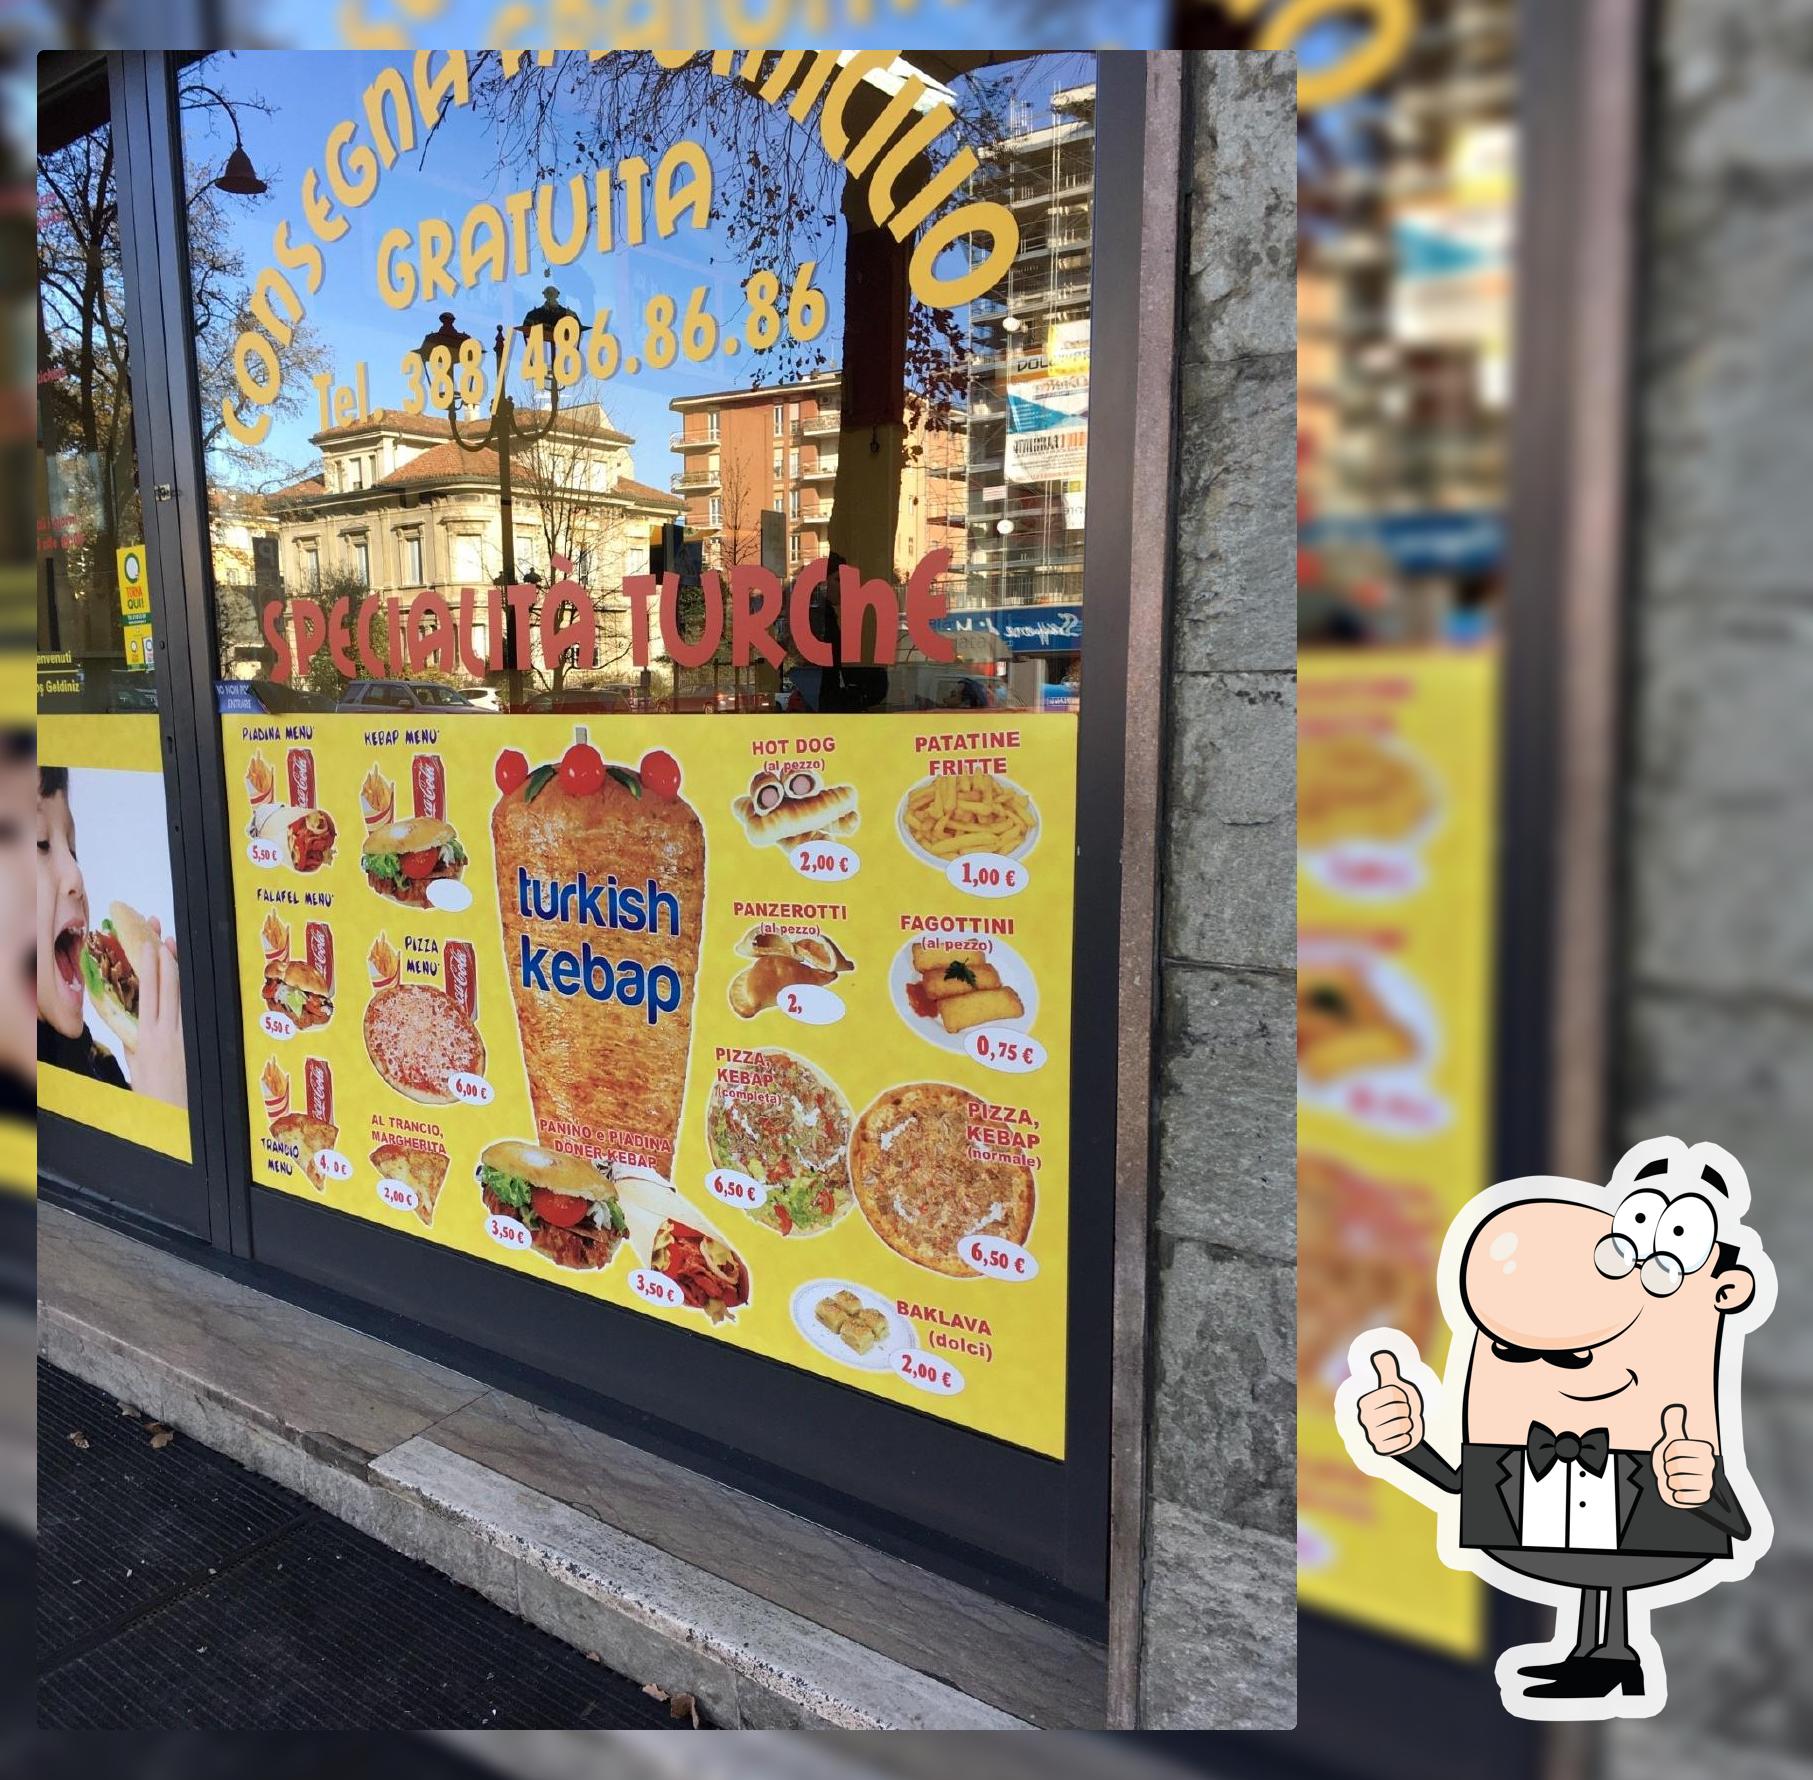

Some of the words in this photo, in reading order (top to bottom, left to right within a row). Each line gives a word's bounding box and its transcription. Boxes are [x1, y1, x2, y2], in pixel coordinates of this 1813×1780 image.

[377, 141, 712, 310] GRATUITA
[401, 262, 828, 415] 388/486.86.86
[263, 552, 596, 683] SPECIALITÀ
[364, 730, 399, 746] KEBAP
[752, 738, 789, 756] HOT
[795, 737, 836, 754] DOG
[915, 731, 1021, 753] PATATINE
[783, 757, 826, 773] pezzo)
[929, 757, 1008, 777] FRITTE
[252, 845, 270, 862] 5,50
[799, 850, 835, 873] 2,00
[839, 857, 849, 873] €
[961, 863, 1000, 887] 1,00
[1005, 870, 1016, 887] €
[256, 889, 299, 904] FALAFEL
[518, 866, 681, 937] turkish
[733, 901, 848, 921] PANZEROTTI
[780, 924, 821, 937] pezzo)
[901, 915, 1015, 935] FAGOTTINI
[404, 936, 439, 954] PIZZA
[944, 937, 993, 953] pezzo)
[520, 934, 683, 1026] kebap
[1022, 1047, 1034, 1065] €
[455, 1078, 479, 1097] 6,00
[717, 1068, 774, 1087] KEBAP
[371, 1114, 386, 1127] AL
[969, 1102, 1040, 1129] PIZZA,
[371, 1131, 447, 1155] MARGHERITA
[540, 1119, 592, 1140] PANINO
[596, 1131, 605, 1141] e
[609, 1130, 672, 1153] PIADINA
[966, 1125, 1041, 1150] KEBAP
[607, 1149, 658, 1169] KEBAP
[967, 1146, 1043, 1170] (normale)
[384, 1187, 405, 1204] 2,00
[713, 1175, 743, 1198] 6,50
[747, 1186, 756, 1202] €
[491, 1219, 514, 1241] 3,50
[971, 1242, 1009, 1270] 6,50
[1014, 1257, 1026, 1274] €
[636, 1274, 663, 1298] 3,50
[896, 1300, 993, 1336] BAKLAVA
[929, 1330, 994, 1362] (dolci)
[901, 1354, 937, 1383] 2,00
[941, 1372, 952, 1388] €
